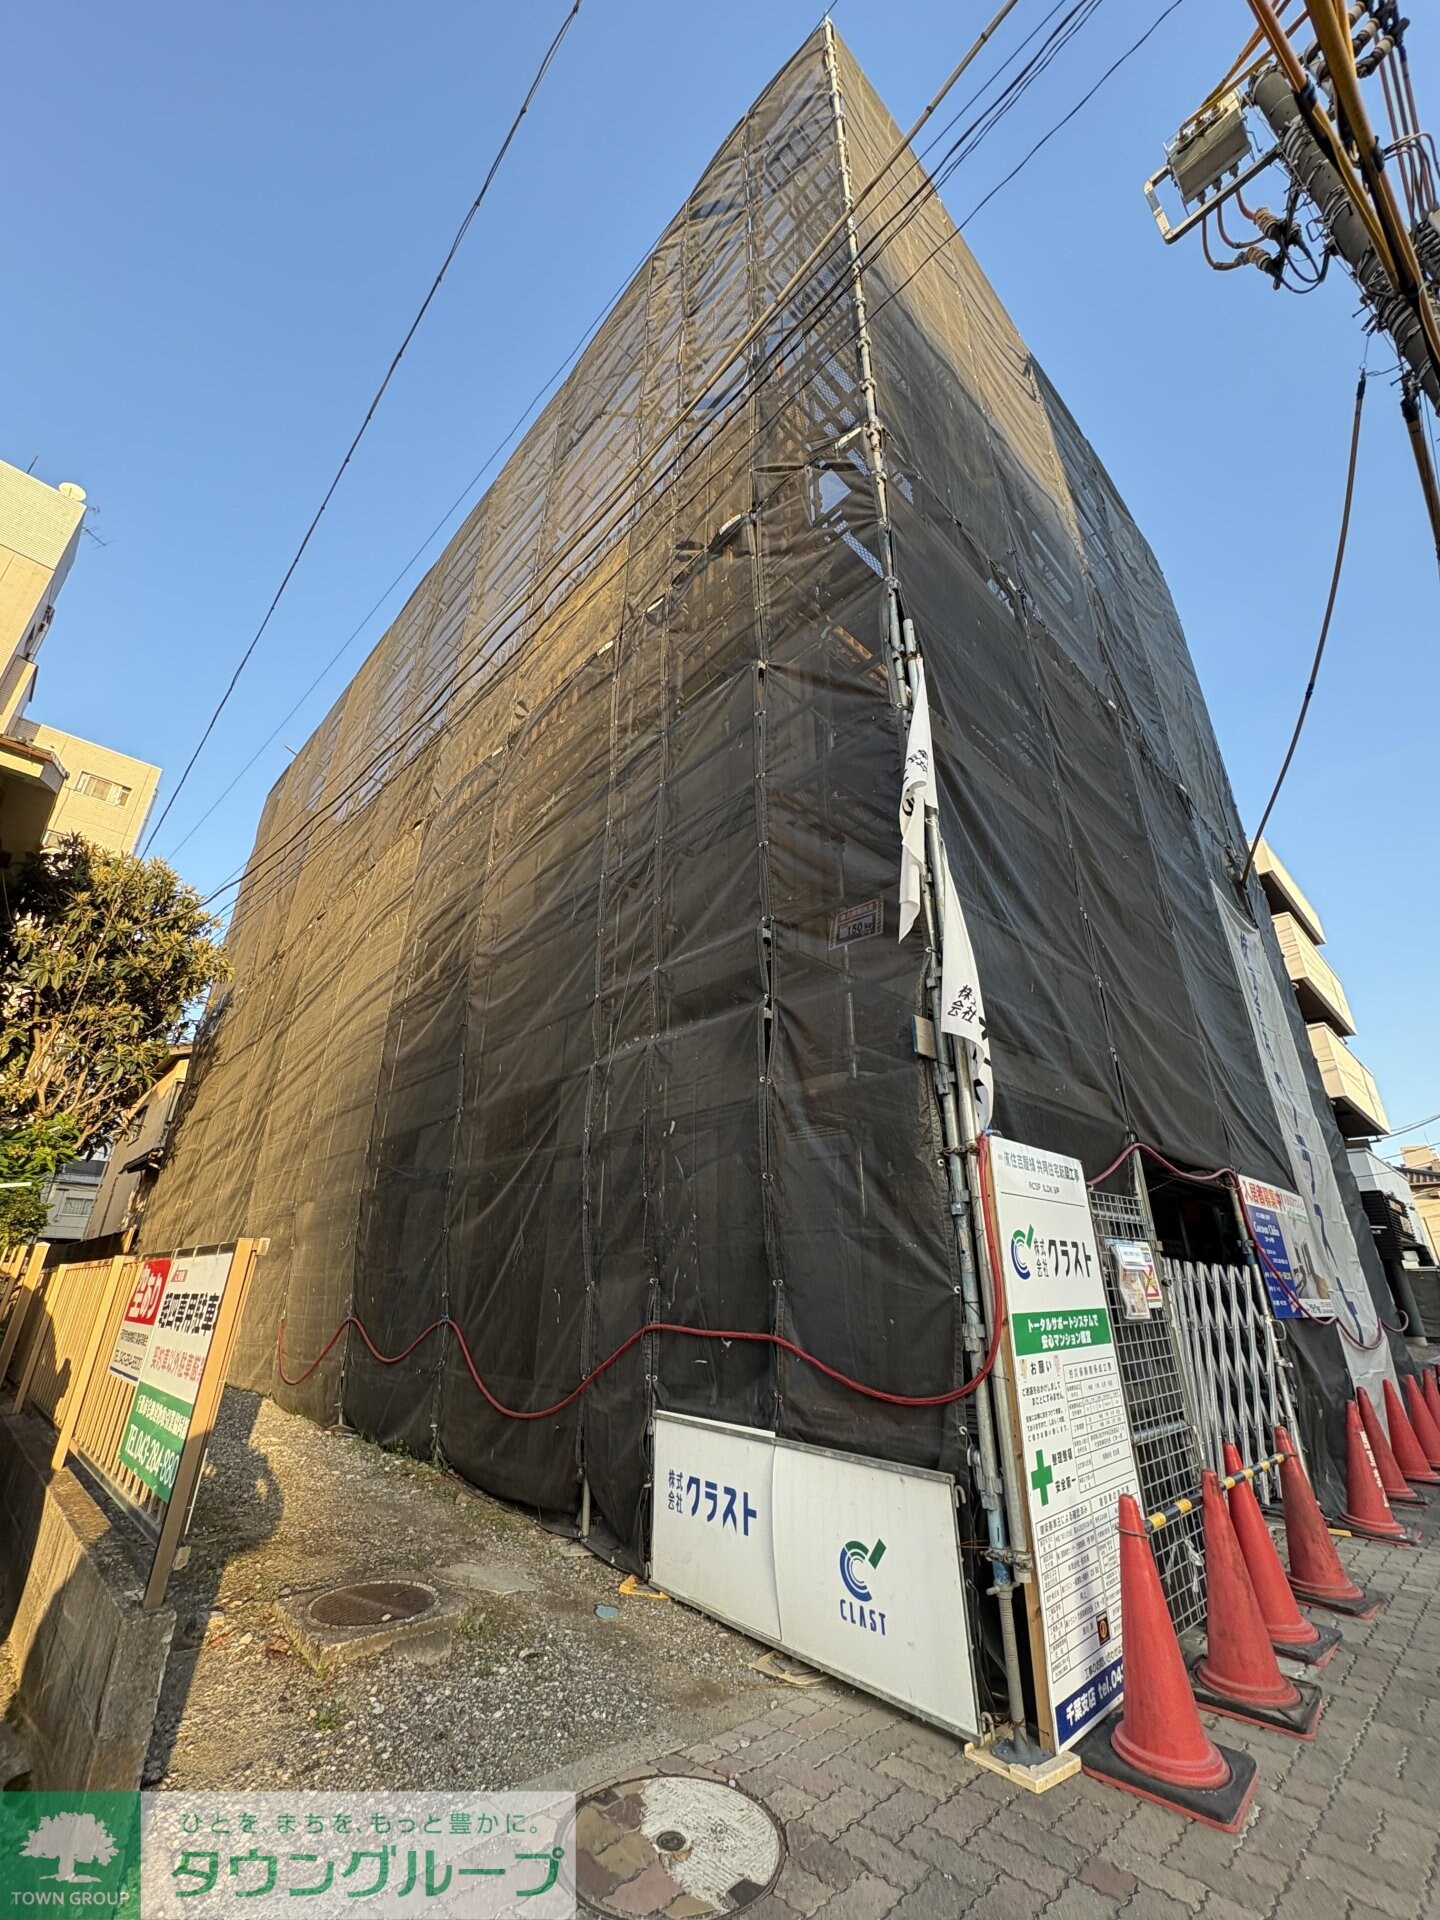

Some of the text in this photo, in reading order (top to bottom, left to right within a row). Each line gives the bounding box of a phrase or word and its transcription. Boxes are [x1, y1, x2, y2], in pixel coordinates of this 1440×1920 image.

[947, 1000, 978, 1024] 会社
[1048, 1239, 1092, 1279] クラスト
[127, 1265, 163, 1319] 空あり
[158, 1292, 220, 1337] 軽四専用駐車
[1027, 1314, 1099, 1333] トータルサポートシステムで
[1041, 1330, 1092, 1349] 安心マンション経営
[1030, 1360, 1052, 1375] お願い
[668, 1468, 683, 1492] 株式
[1055, 1476, 1077, 1494] 安全第一
[667, 1490, 683, 1514] 会社
[686, 1475, 757, 1537] クラスト
[839, 1598, 887, 1637] CLAST
[1066, 1687, 1096, 1727] 千葉支店
